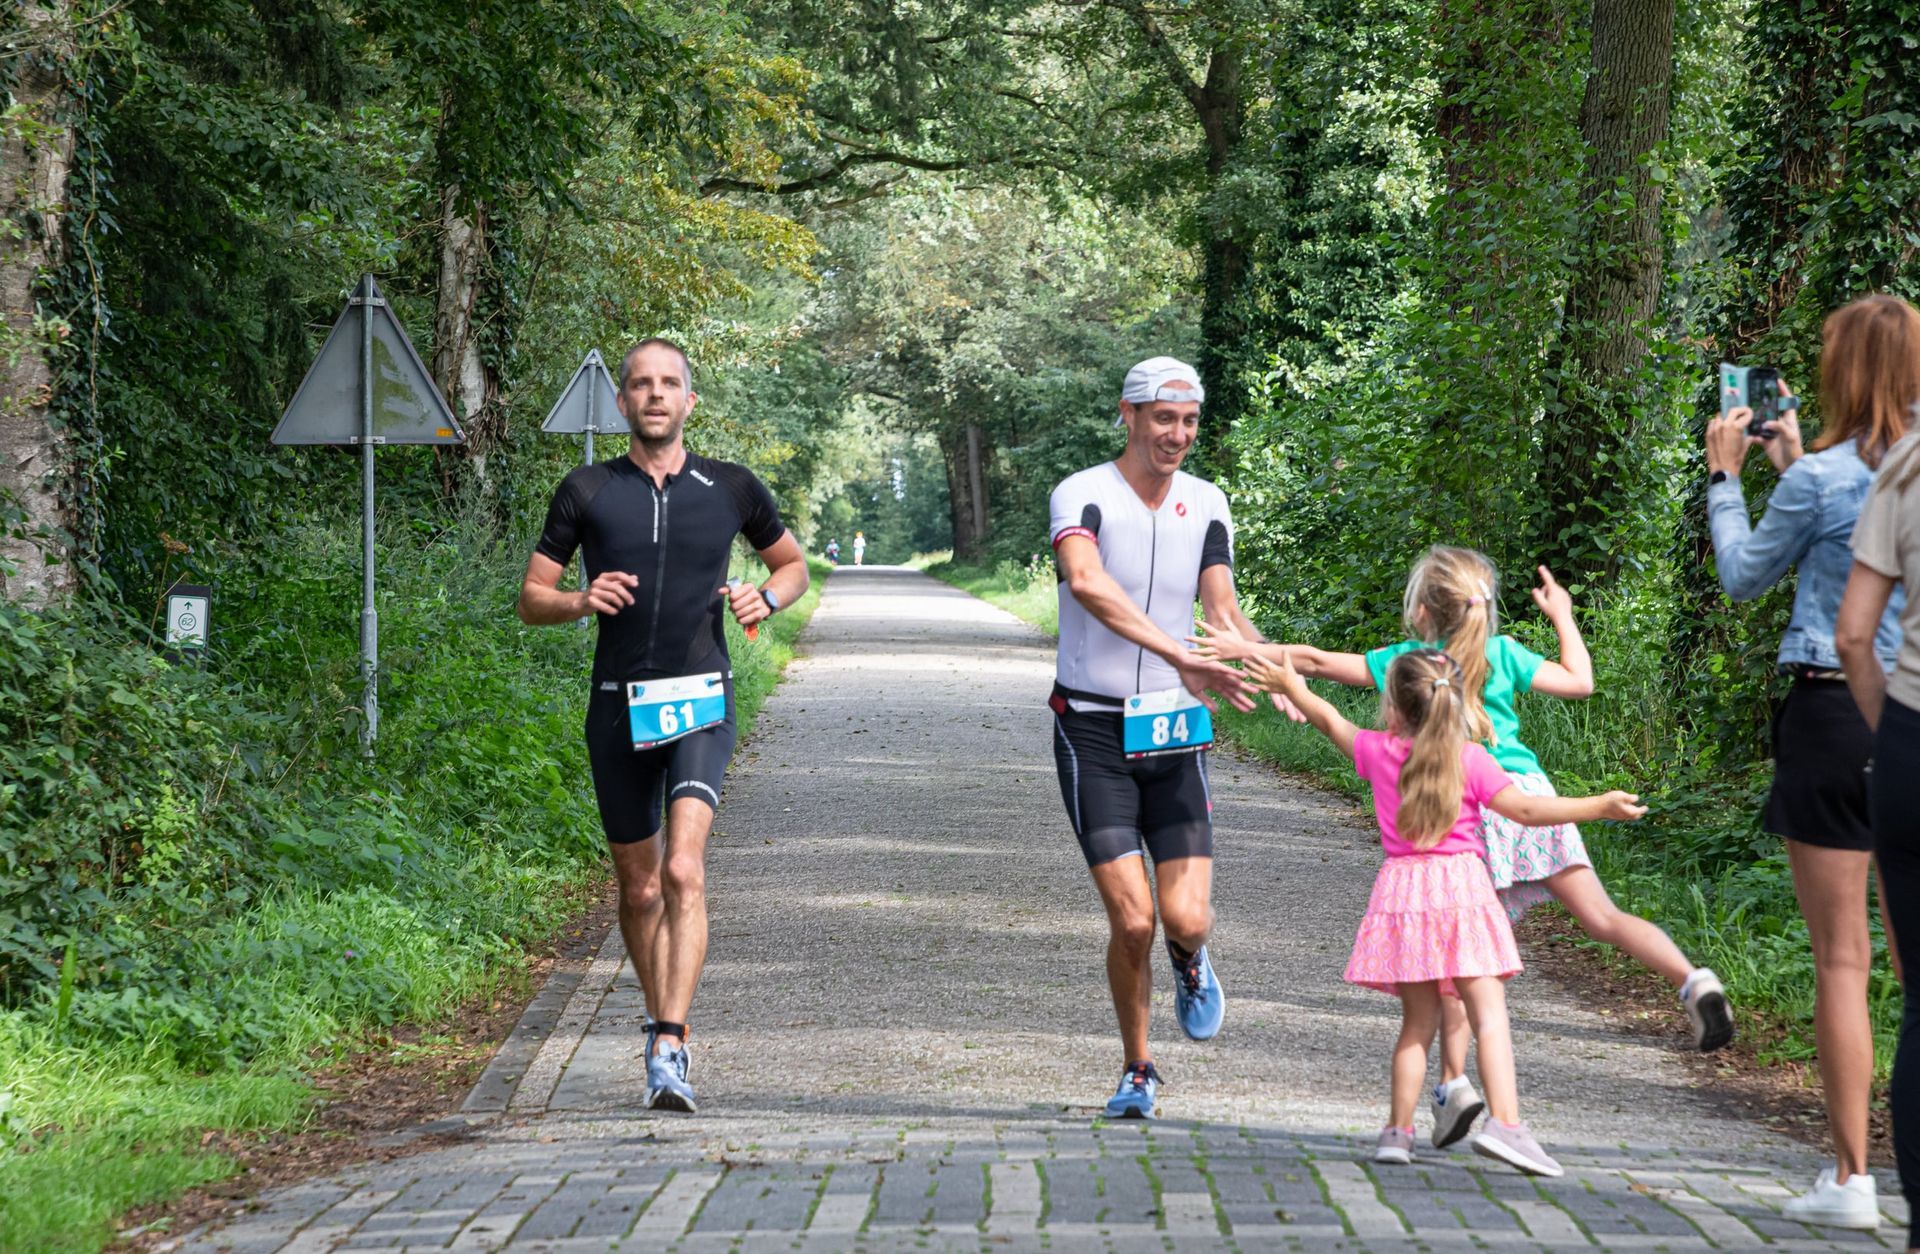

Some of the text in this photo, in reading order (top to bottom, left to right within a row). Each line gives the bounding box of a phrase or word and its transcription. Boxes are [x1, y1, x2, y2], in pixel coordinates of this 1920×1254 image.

[181, 617, 194, 626] 62
[659, 701, 695, 735] 61
[1152, 712, 1189, 746] 84
